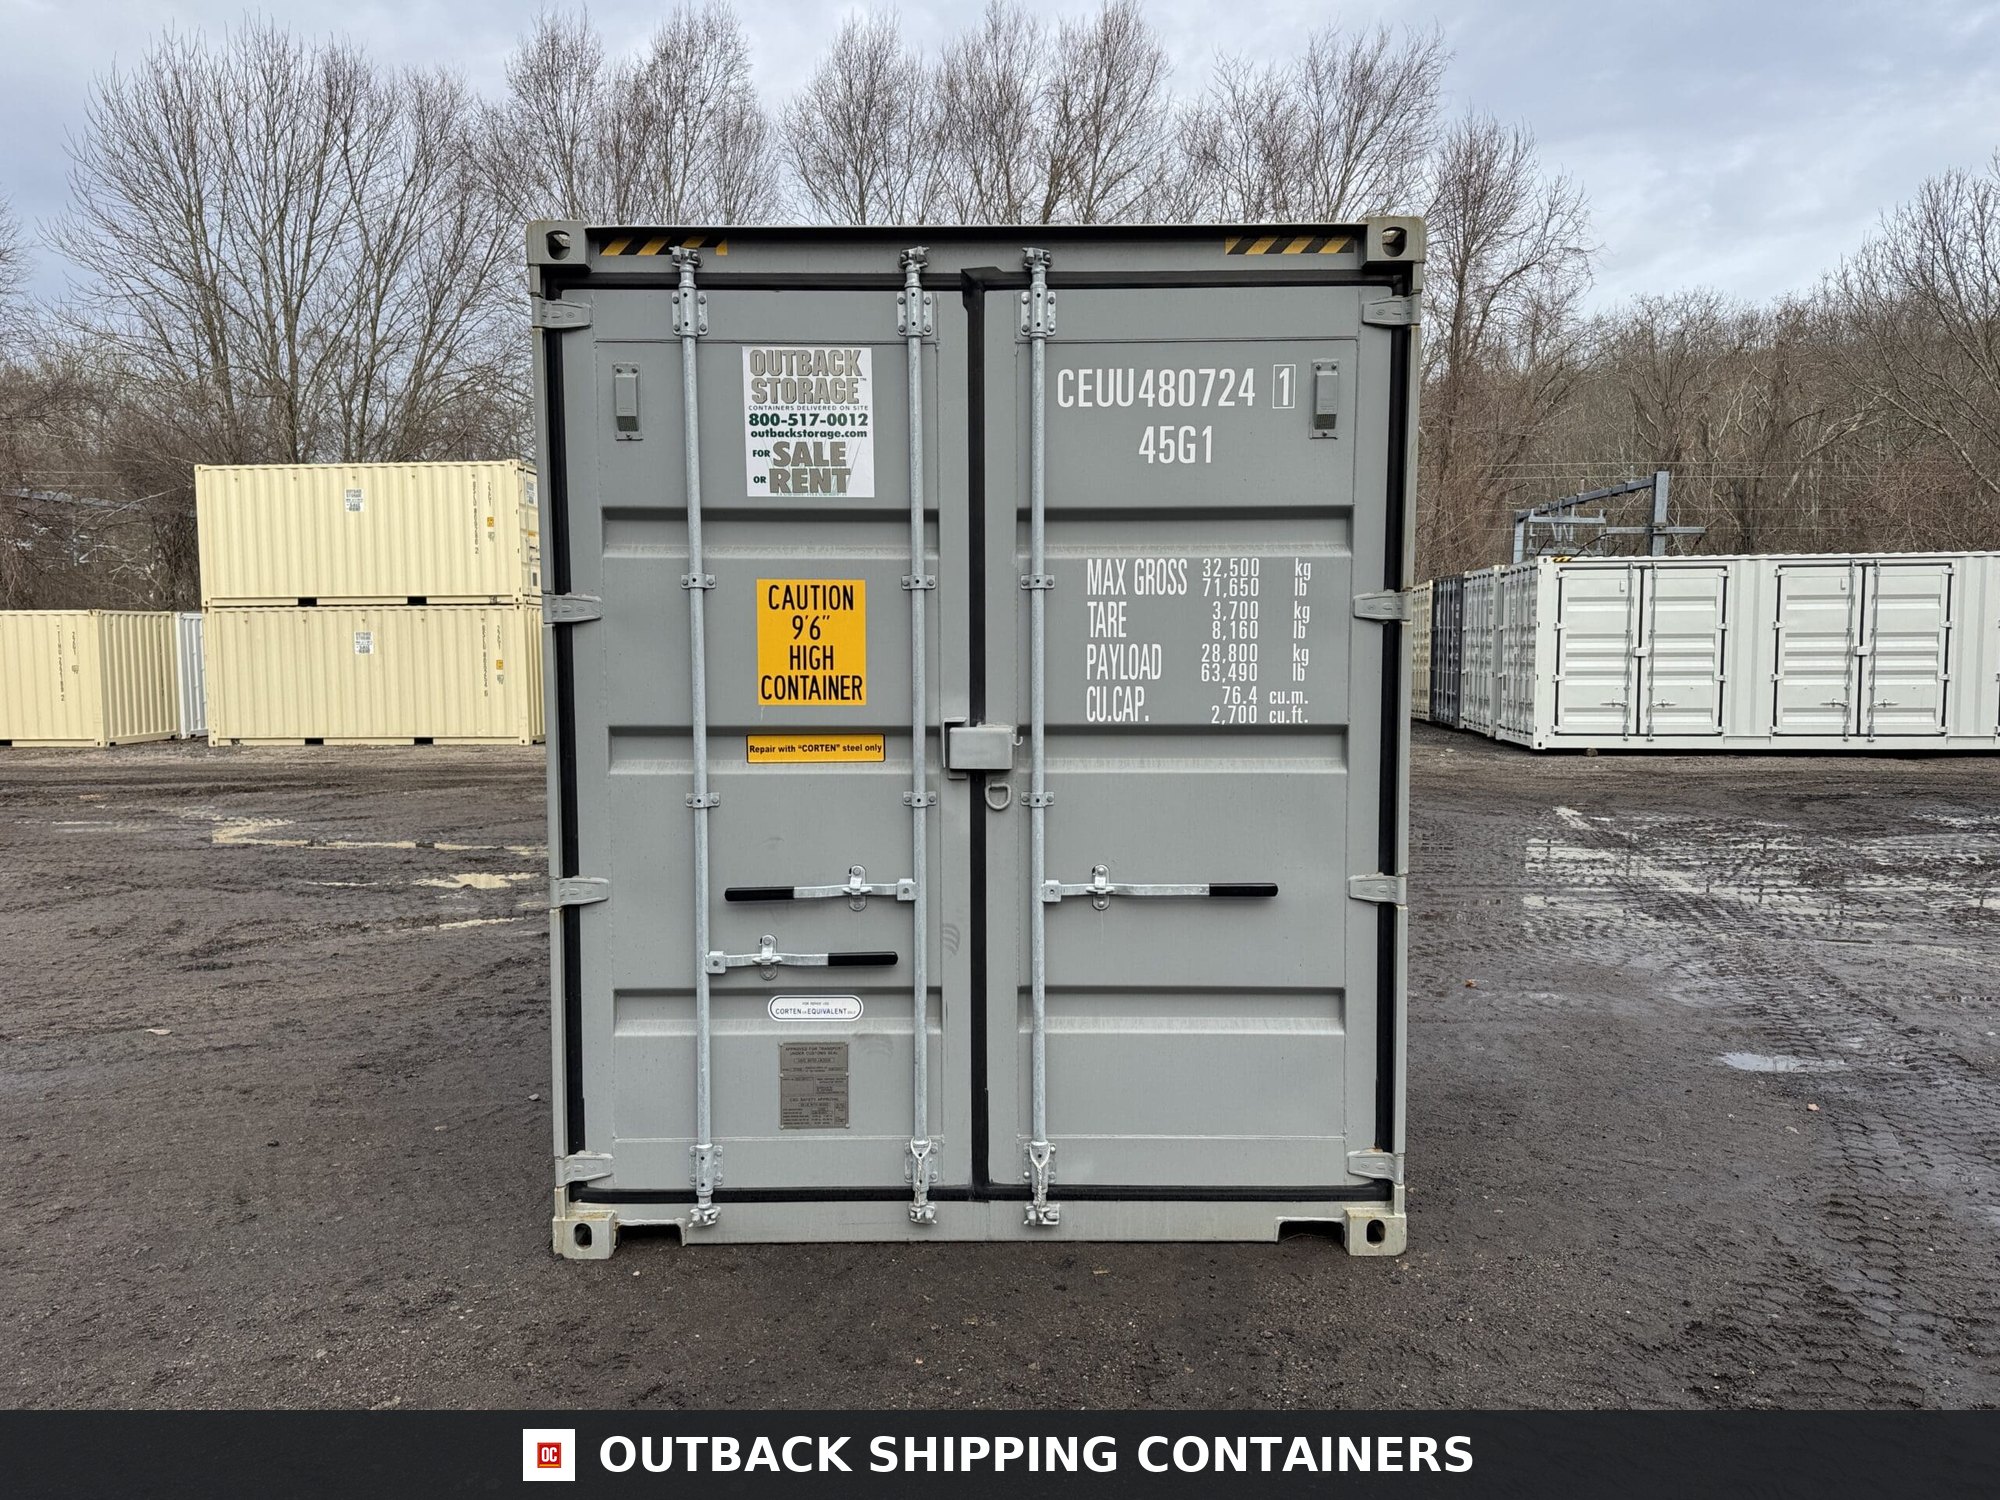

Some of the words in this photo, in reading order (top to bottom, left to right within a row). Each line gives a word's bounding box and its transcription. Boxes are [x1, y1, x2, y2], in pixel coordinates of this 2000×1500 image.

[750, 349, 863, 376] OUTBACK
[1058, 368, 1256, 408] CEUU480724
[1279, 367, 1290, 406] 1
[748, 413, 868, 427] 800-517-0012
[750, 428, 868, 440] outbackstorage.com
[1138, 425, 1213, 464] 45G1
[752, 449, 771, 458] FOR
[772, 441, 847, 467] SALE
[753, 475, 767, 484] OR
[769, 468, 851, 494] RENT
[1087, 558, 1127, 596] MAX
[1134, 558, 1188, 596] GROSS
[1202, 557, 1260, 579] 32,500
[1295, 557, 1312, 581] kg
[768, 584, 855, 611] CAUTION
[1202, 577, 1260, 599] 71,650
[1294, 577, 1308, 597] lb
[1087, 601, 1128, 638] TARE
[1212, 600, 1259, 622] 3,700
[1293, 600, 1311, 624] kg
[1212, 620, 1259, 641] 8,160
[1293, 620, 1306, 639] lb
[789, 644, 834, 671] HIGH
[1086, 643, 1162, 681] PAYLOAD
[1201, 643, 1258, 664] 28,800
[1292, 643, 1310, 667] kg
[1201, 662, 1258, 683] 63,490
[1292, 662, 1306, 682] lb
[761, 674, 863, 701] CONTAINER
[1222, 685, 1258, 705] 76.4
[1269, 689, 1309, 705] cu.m.
[1086, 685, 1150, 722] CU.CAP.
[1211, 705, 1257, 725] 2,700
[1269, 705, 1309, 724] cu.ft.
[749, 745, 775, 755] Repair
[778, 744, 796, 753] with
[842, 743, 863, 752] steel
[864, 743, 882, 753] only
